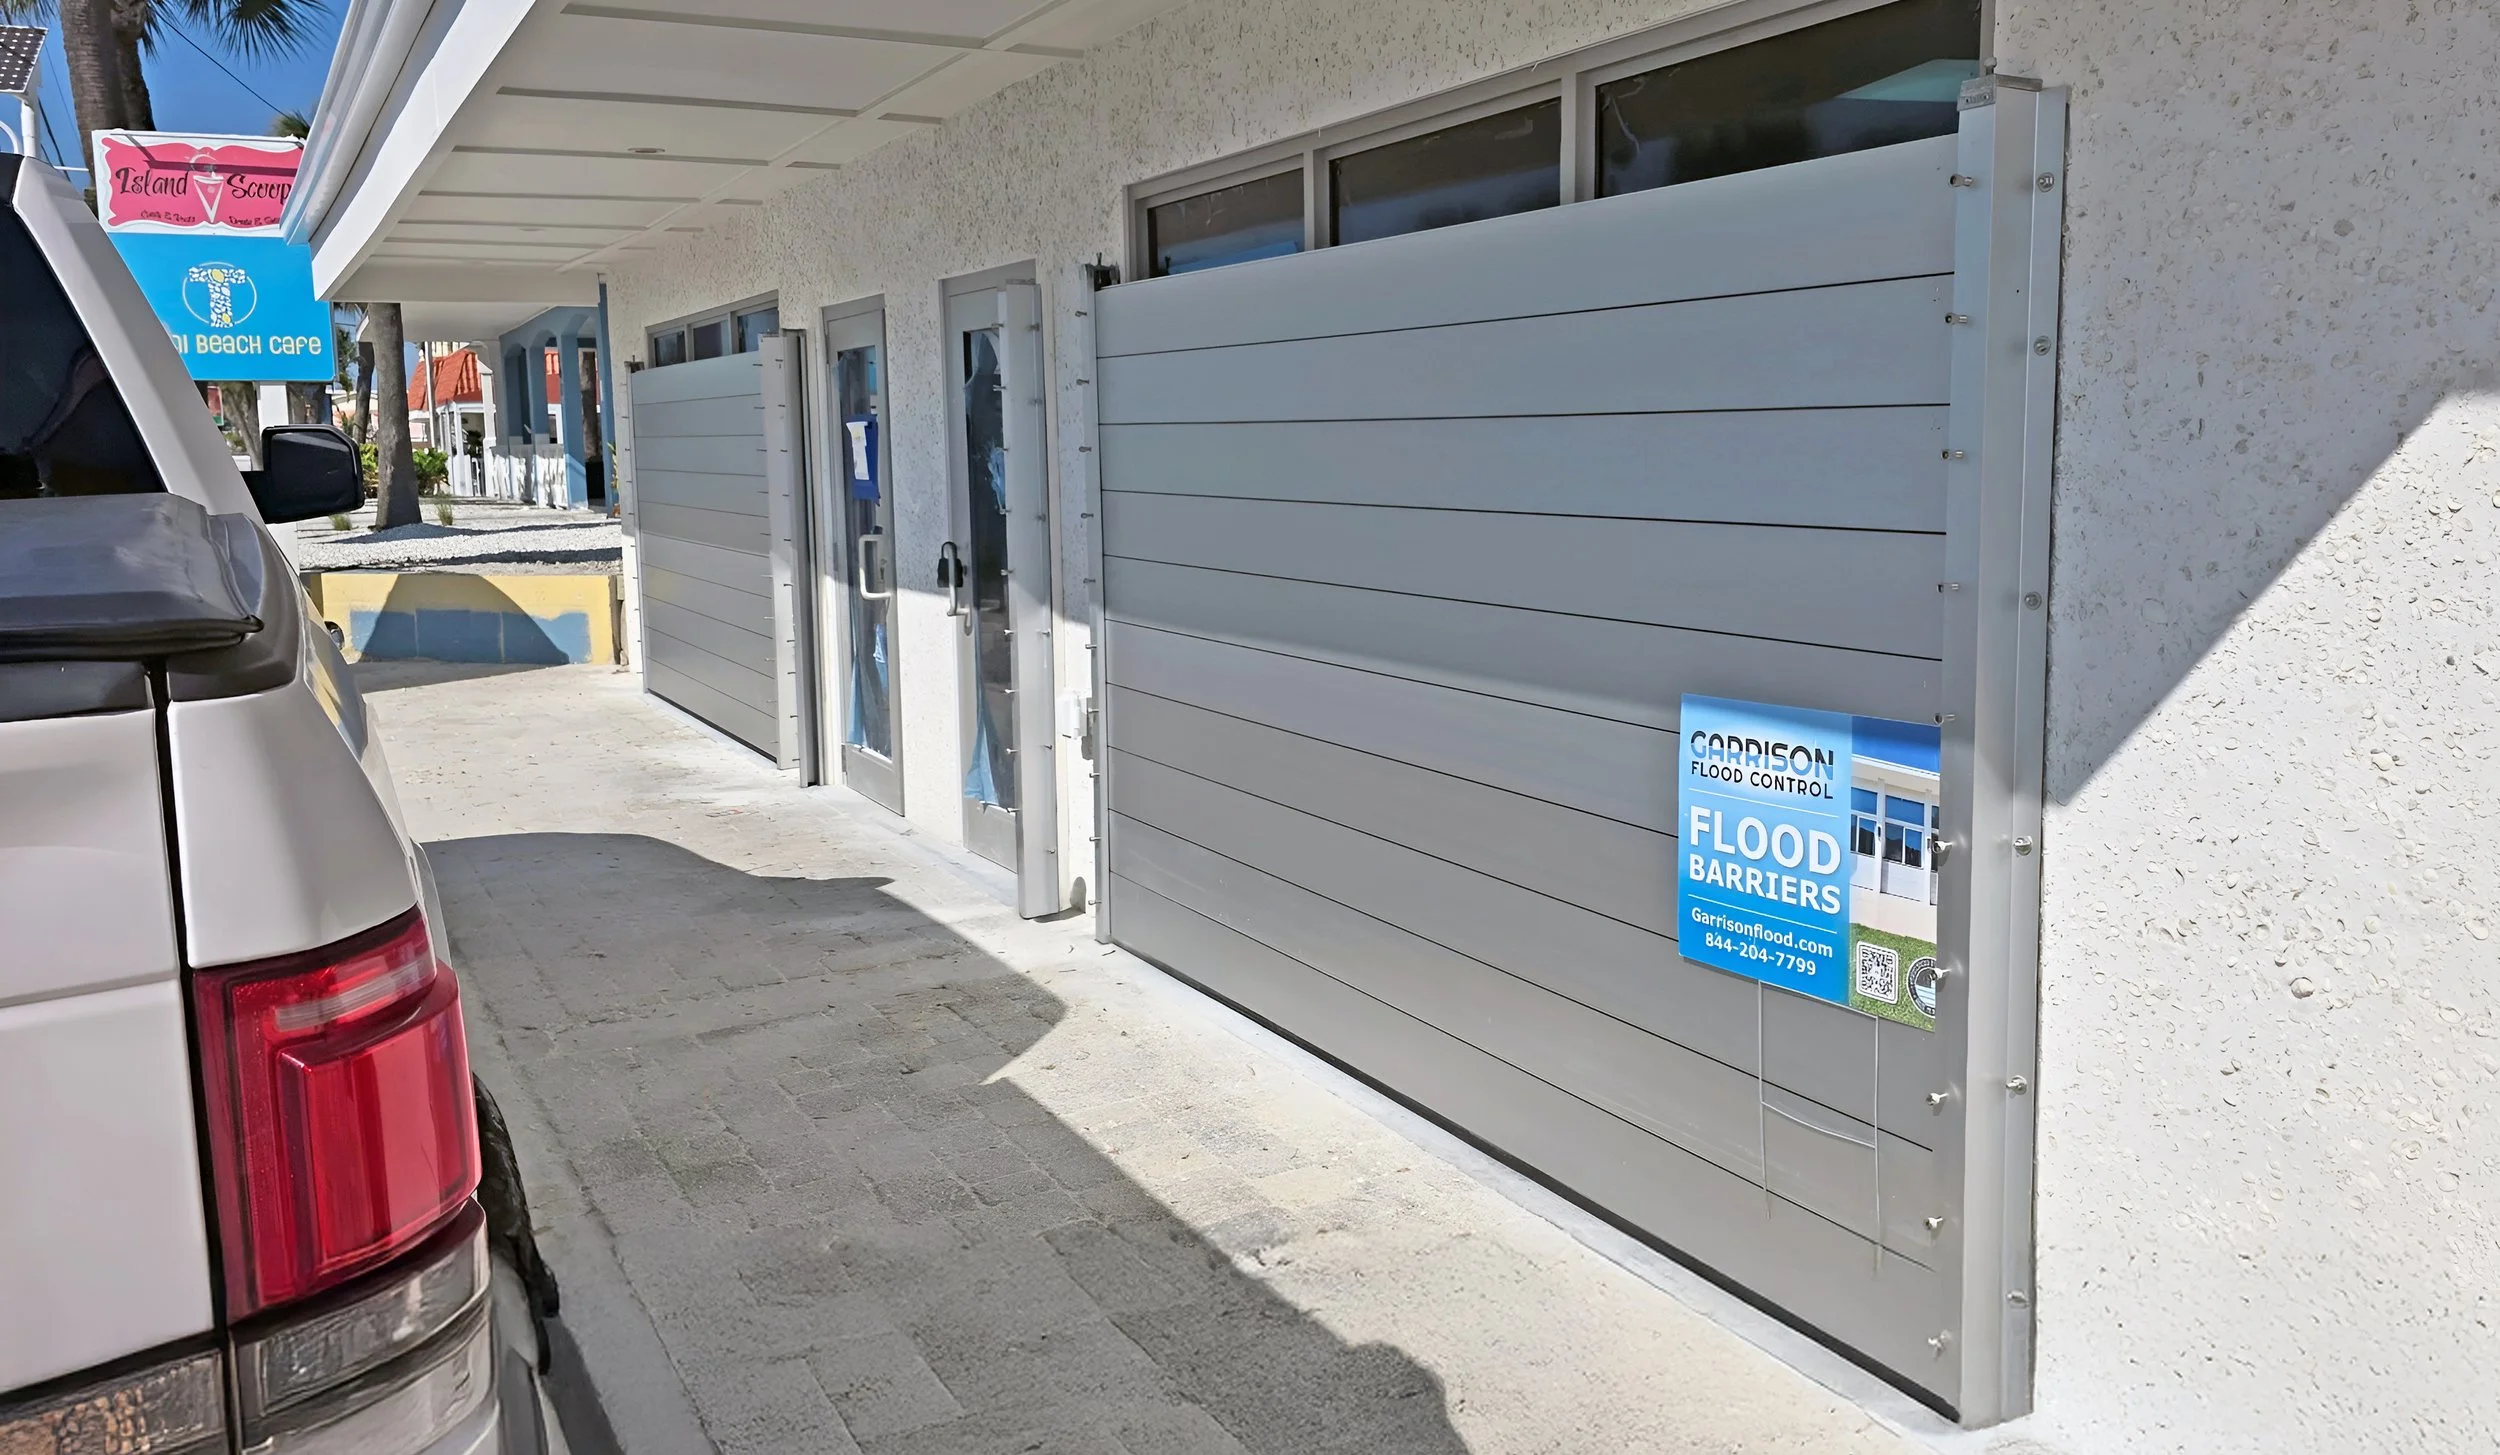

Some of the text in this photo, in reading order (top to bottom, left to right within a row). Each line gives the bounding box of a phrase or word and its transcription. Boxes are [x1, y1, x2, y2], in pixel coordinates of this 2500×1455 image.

[116, 167, 188, 197] Island
[1690, 730, 1834, 780] GARRISON
[1691, 761, 1833, 799] FLOOD CONTROL
[1690, 805, 1841, 875] FLOOD
[1689, 853, 1841, 915] BARRIERS
[1691, 907, 1833, 958] Garrisonflood.com
[1705, 932, 1816, 976] 844-204-7799
